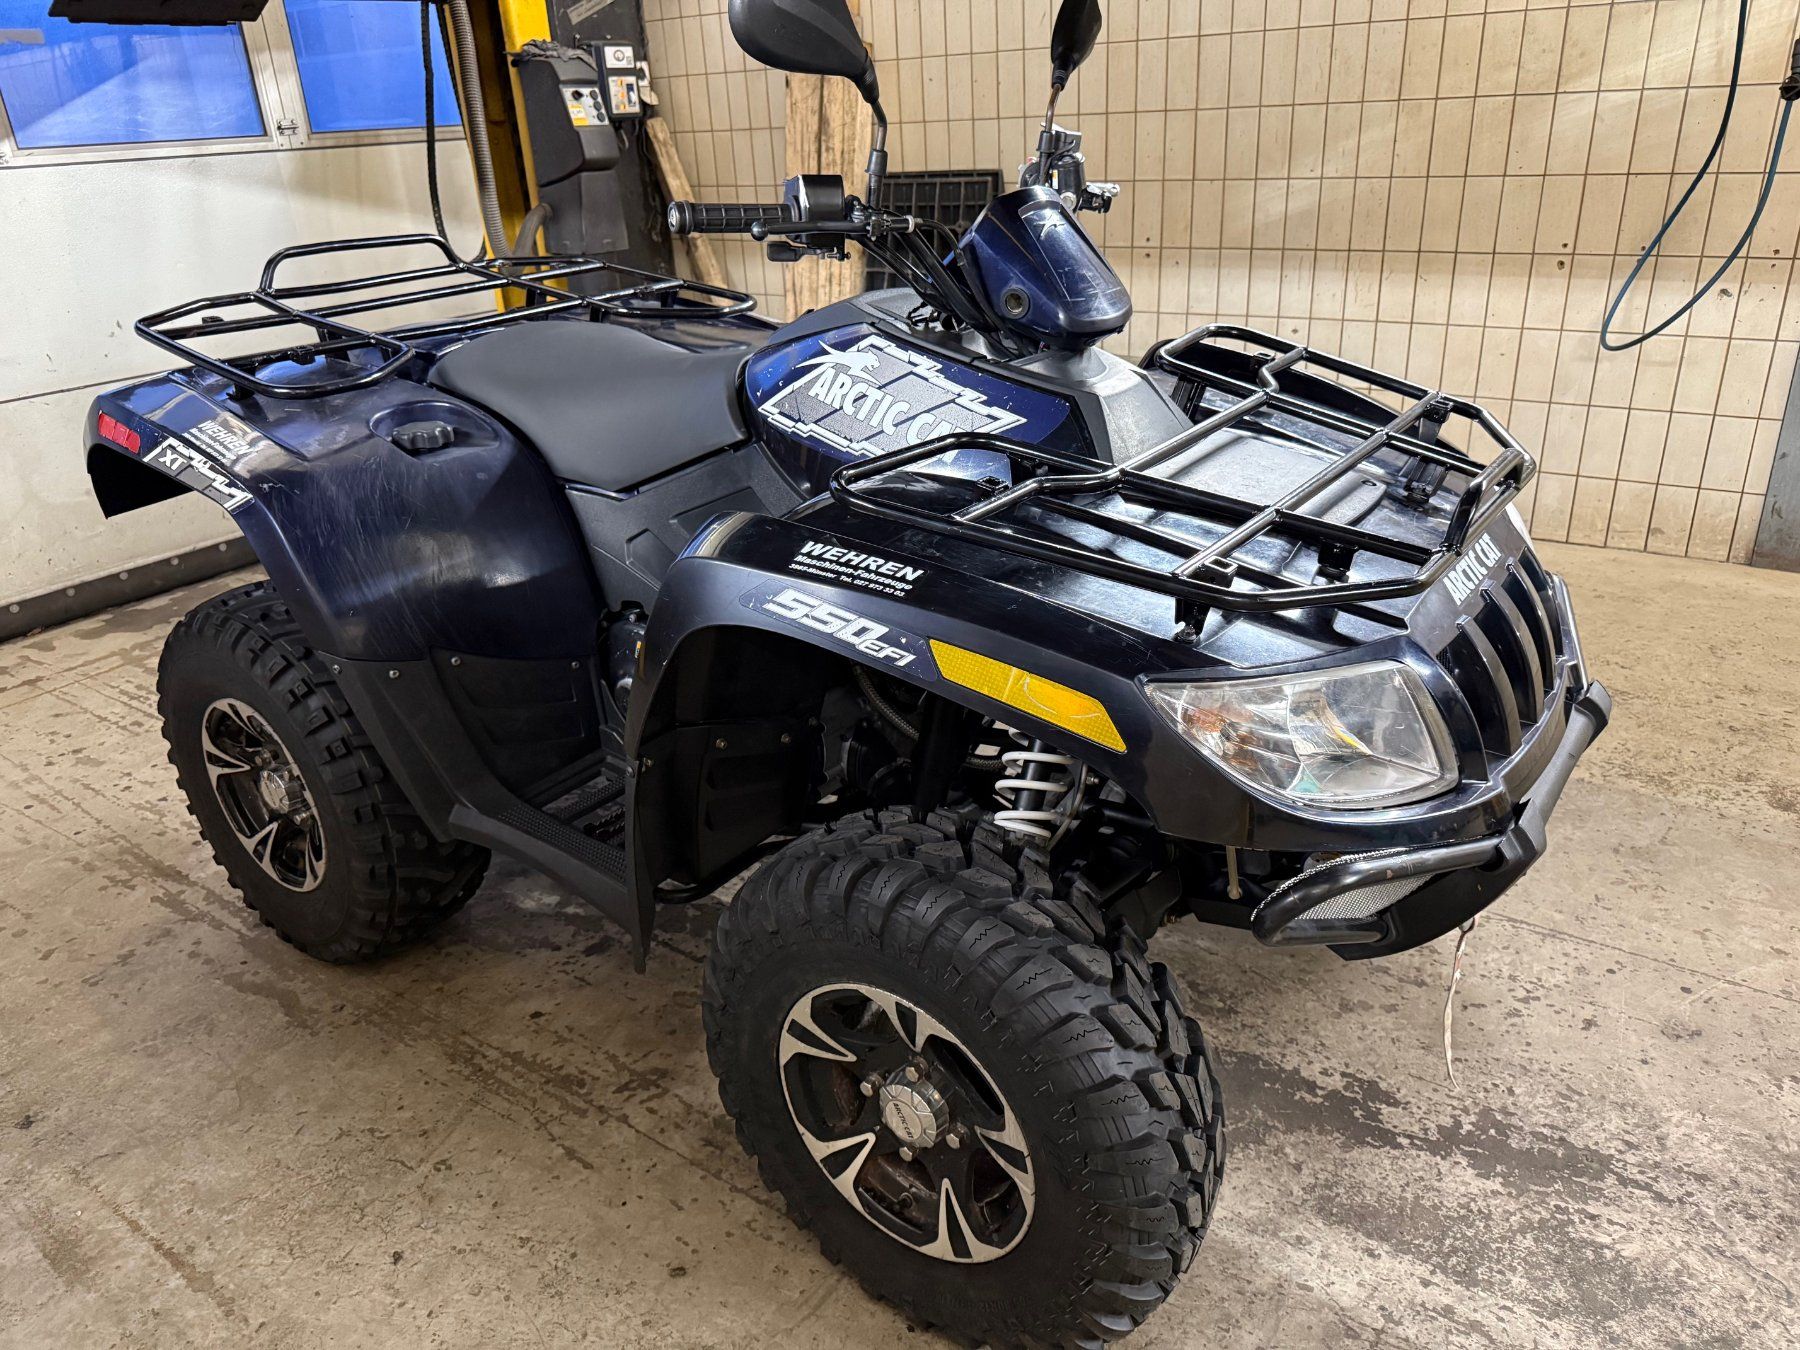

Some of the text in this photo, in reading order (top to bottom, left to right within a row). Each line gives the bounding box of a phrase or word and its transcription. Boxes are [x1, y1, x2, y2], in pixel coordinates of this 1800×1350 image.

[808, 366, 911, 436] ARCTIC
[198, 420, 252, 454] WEHREN
[158, 449, 188, 471] XT
[794, 555, 913, 591] Maschinen-Fahrzeuge
[800, 541, 925, 581] WEHREN
[1443, 532, 1501, 606] ARCTIC CAT
[762, 587, 917, 666] 550 EFI
